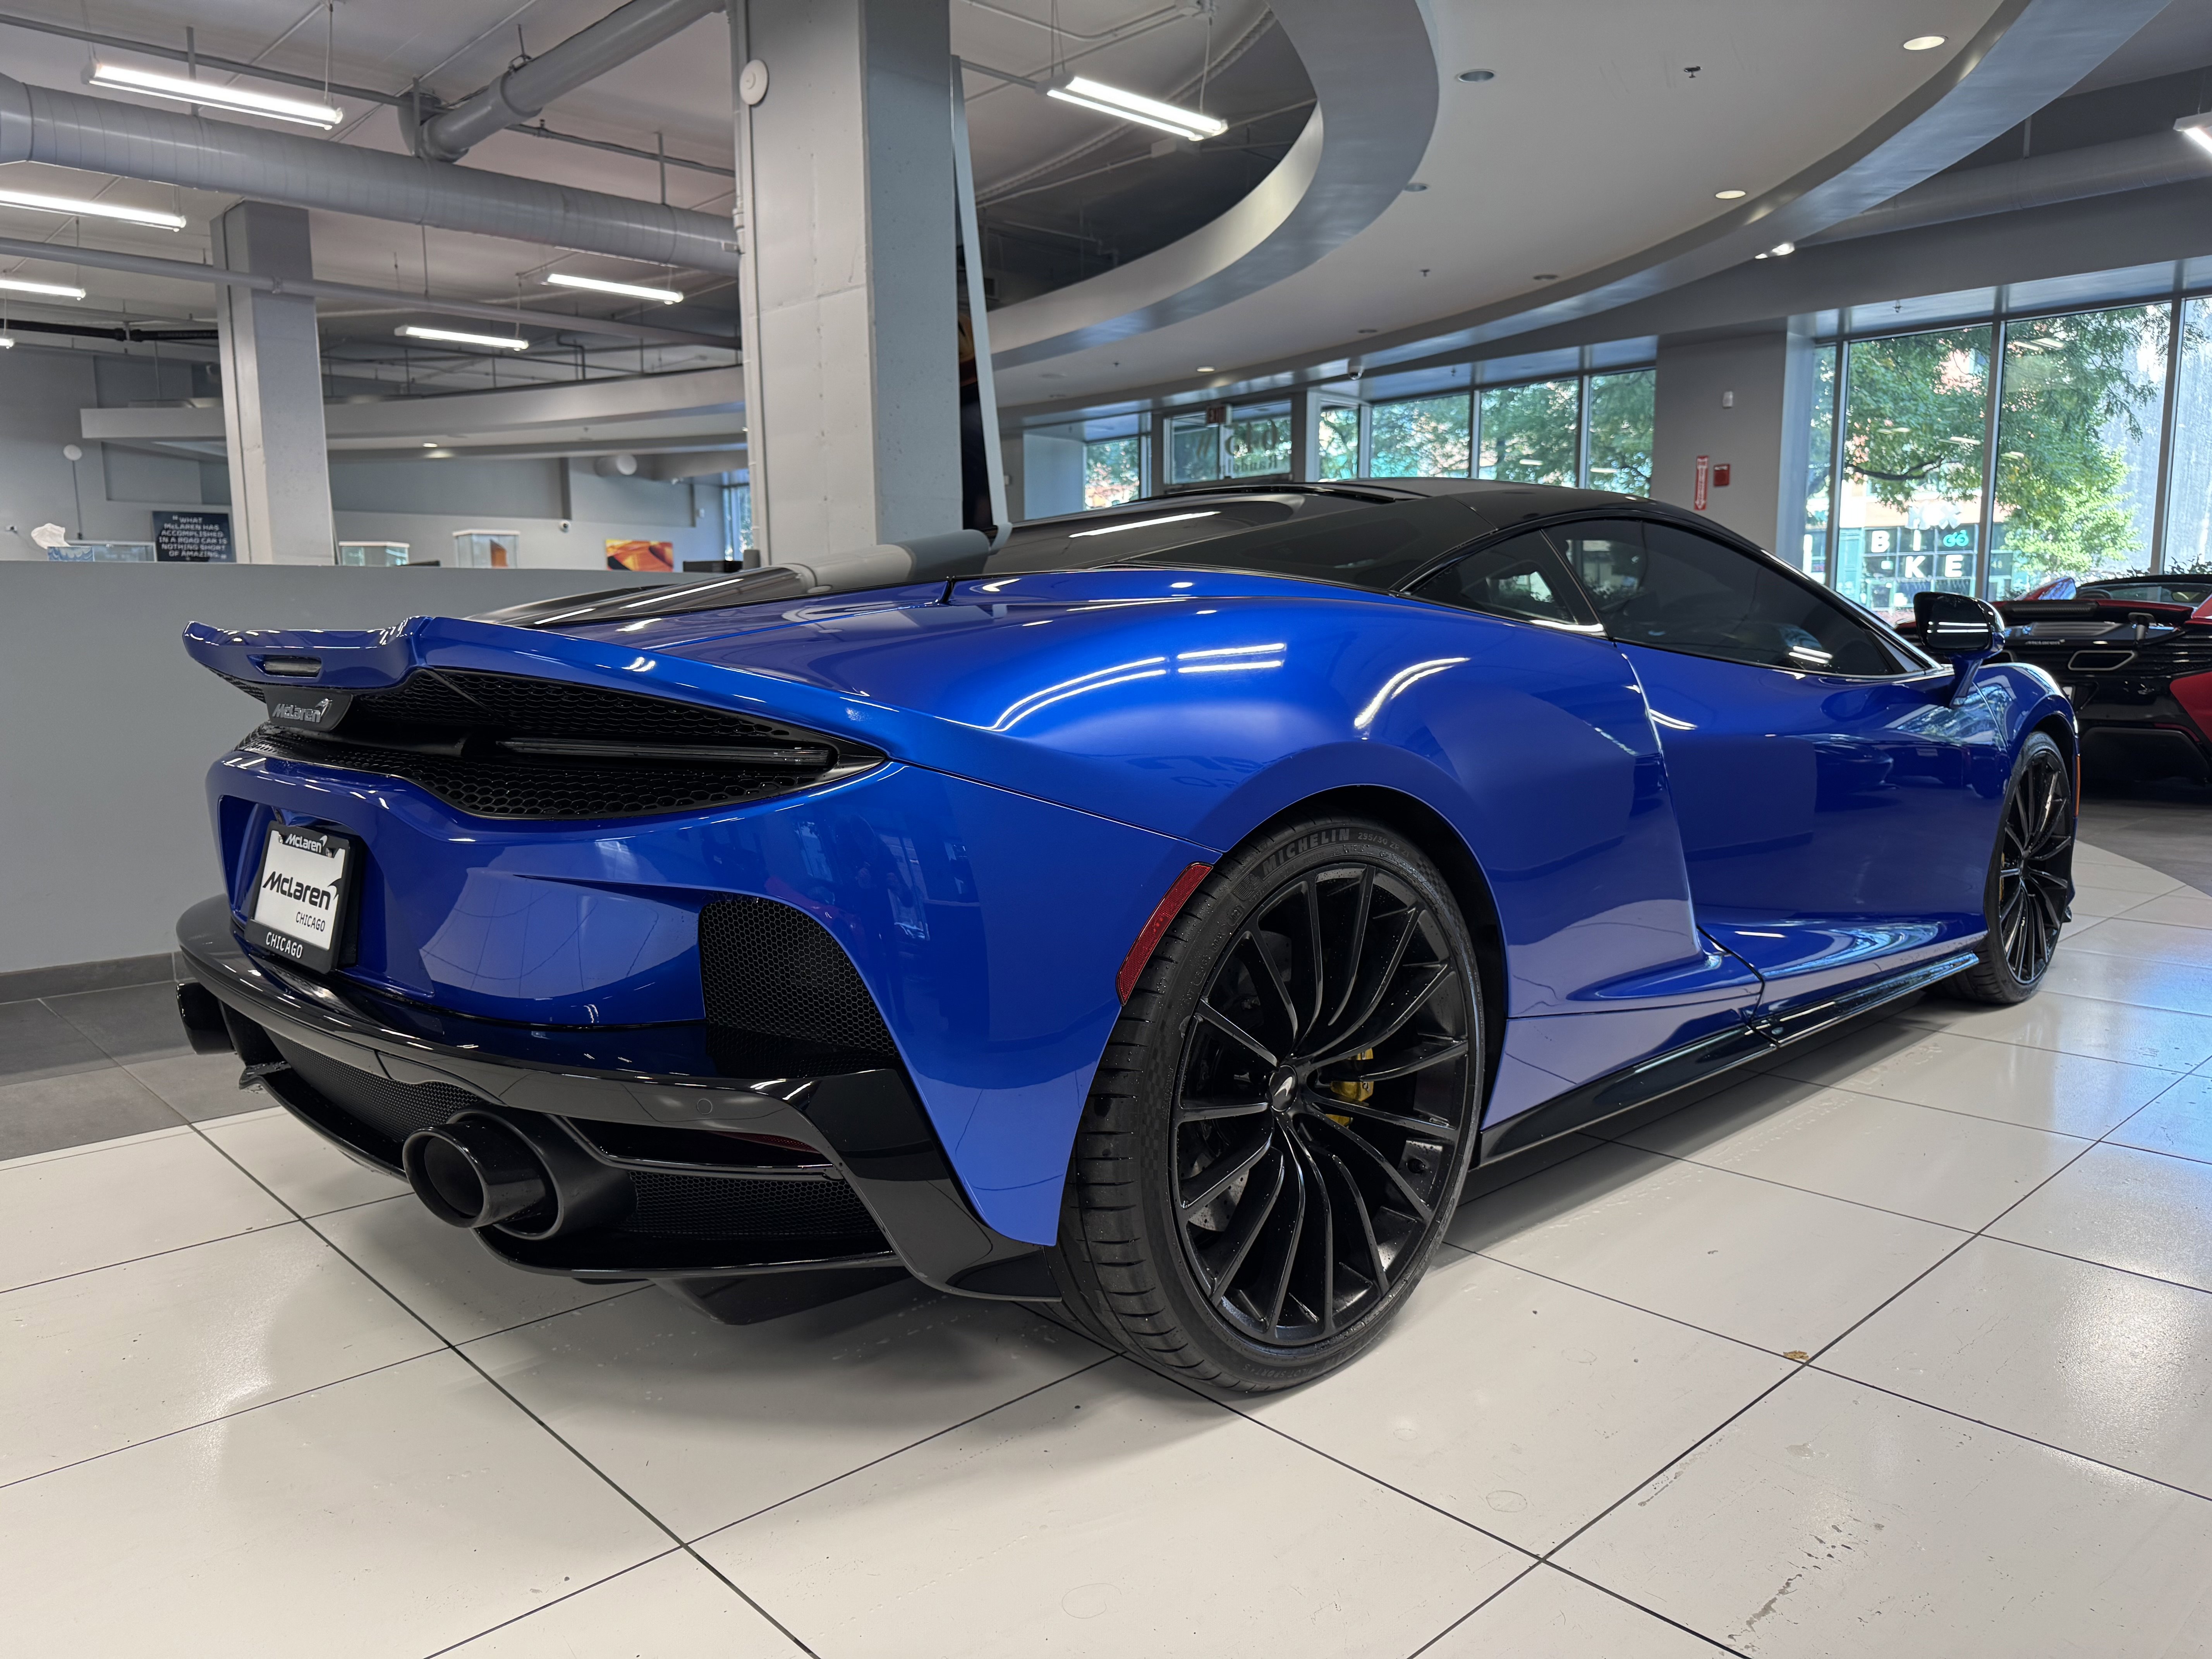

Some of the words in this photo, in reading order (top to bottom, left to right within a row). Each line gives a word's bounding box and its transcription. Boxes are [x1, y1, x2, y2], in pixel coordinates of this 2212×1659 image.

[272, 703, 321, 723] McLaren
[285, 834, 322, 853] McLaren
[1262, 829, 1350, 875] MICHELIN
[1358, 832, 1388, 845] 295/30
[263, 871, 331, 910] McLaren
[295, 911, 326, 932] CHICAGO
[266, 932, 303, 959] CHICAGO
